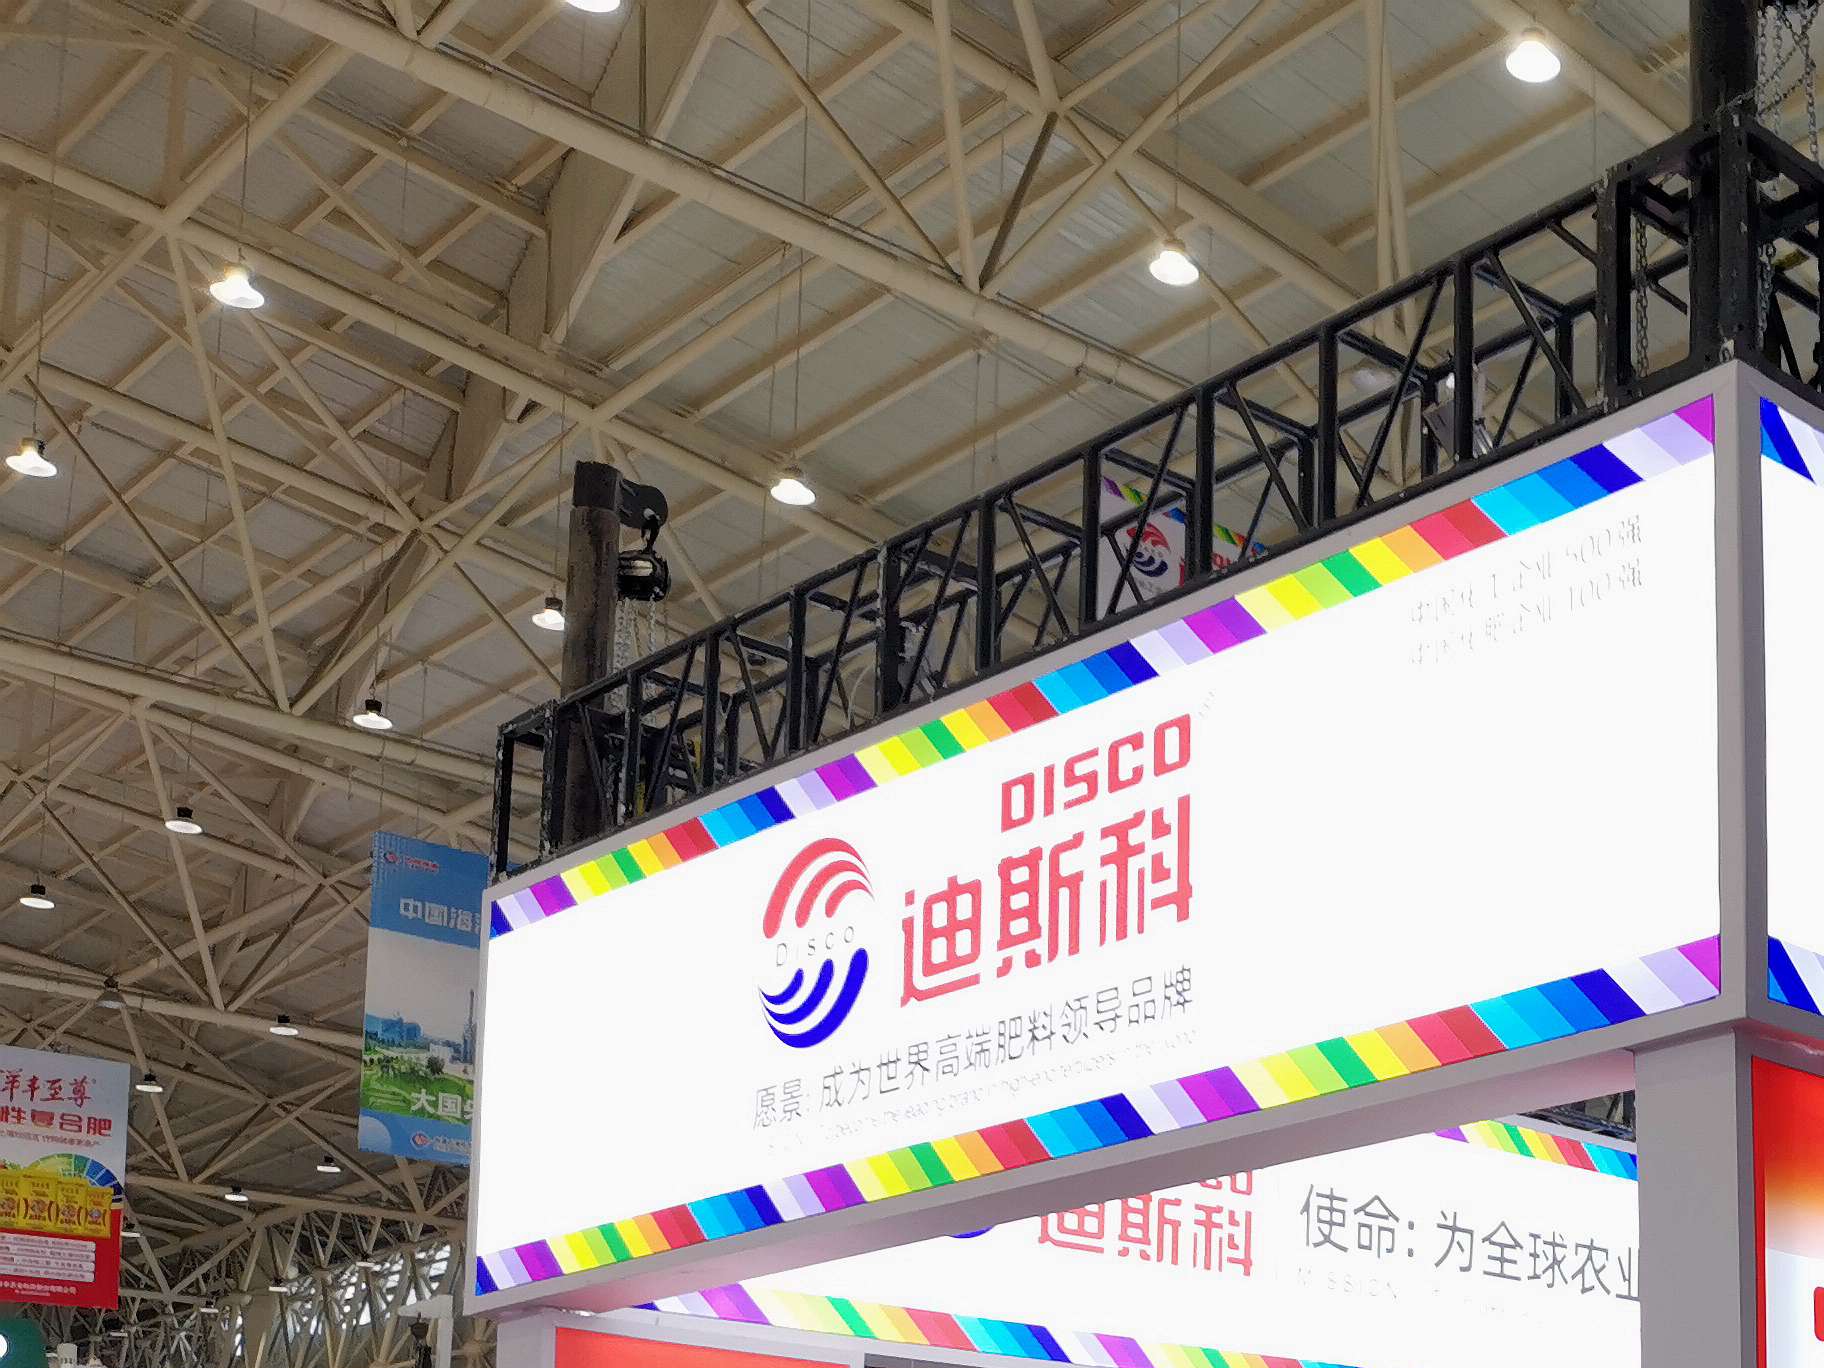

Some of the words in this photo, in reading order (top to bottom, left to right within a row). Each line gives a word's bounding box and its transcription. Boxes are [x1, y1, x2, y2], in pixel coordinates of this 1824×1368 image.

[1001, 713, 1191, 832] DISCO
[901, 795, 1193, 1008] 迪斯科
